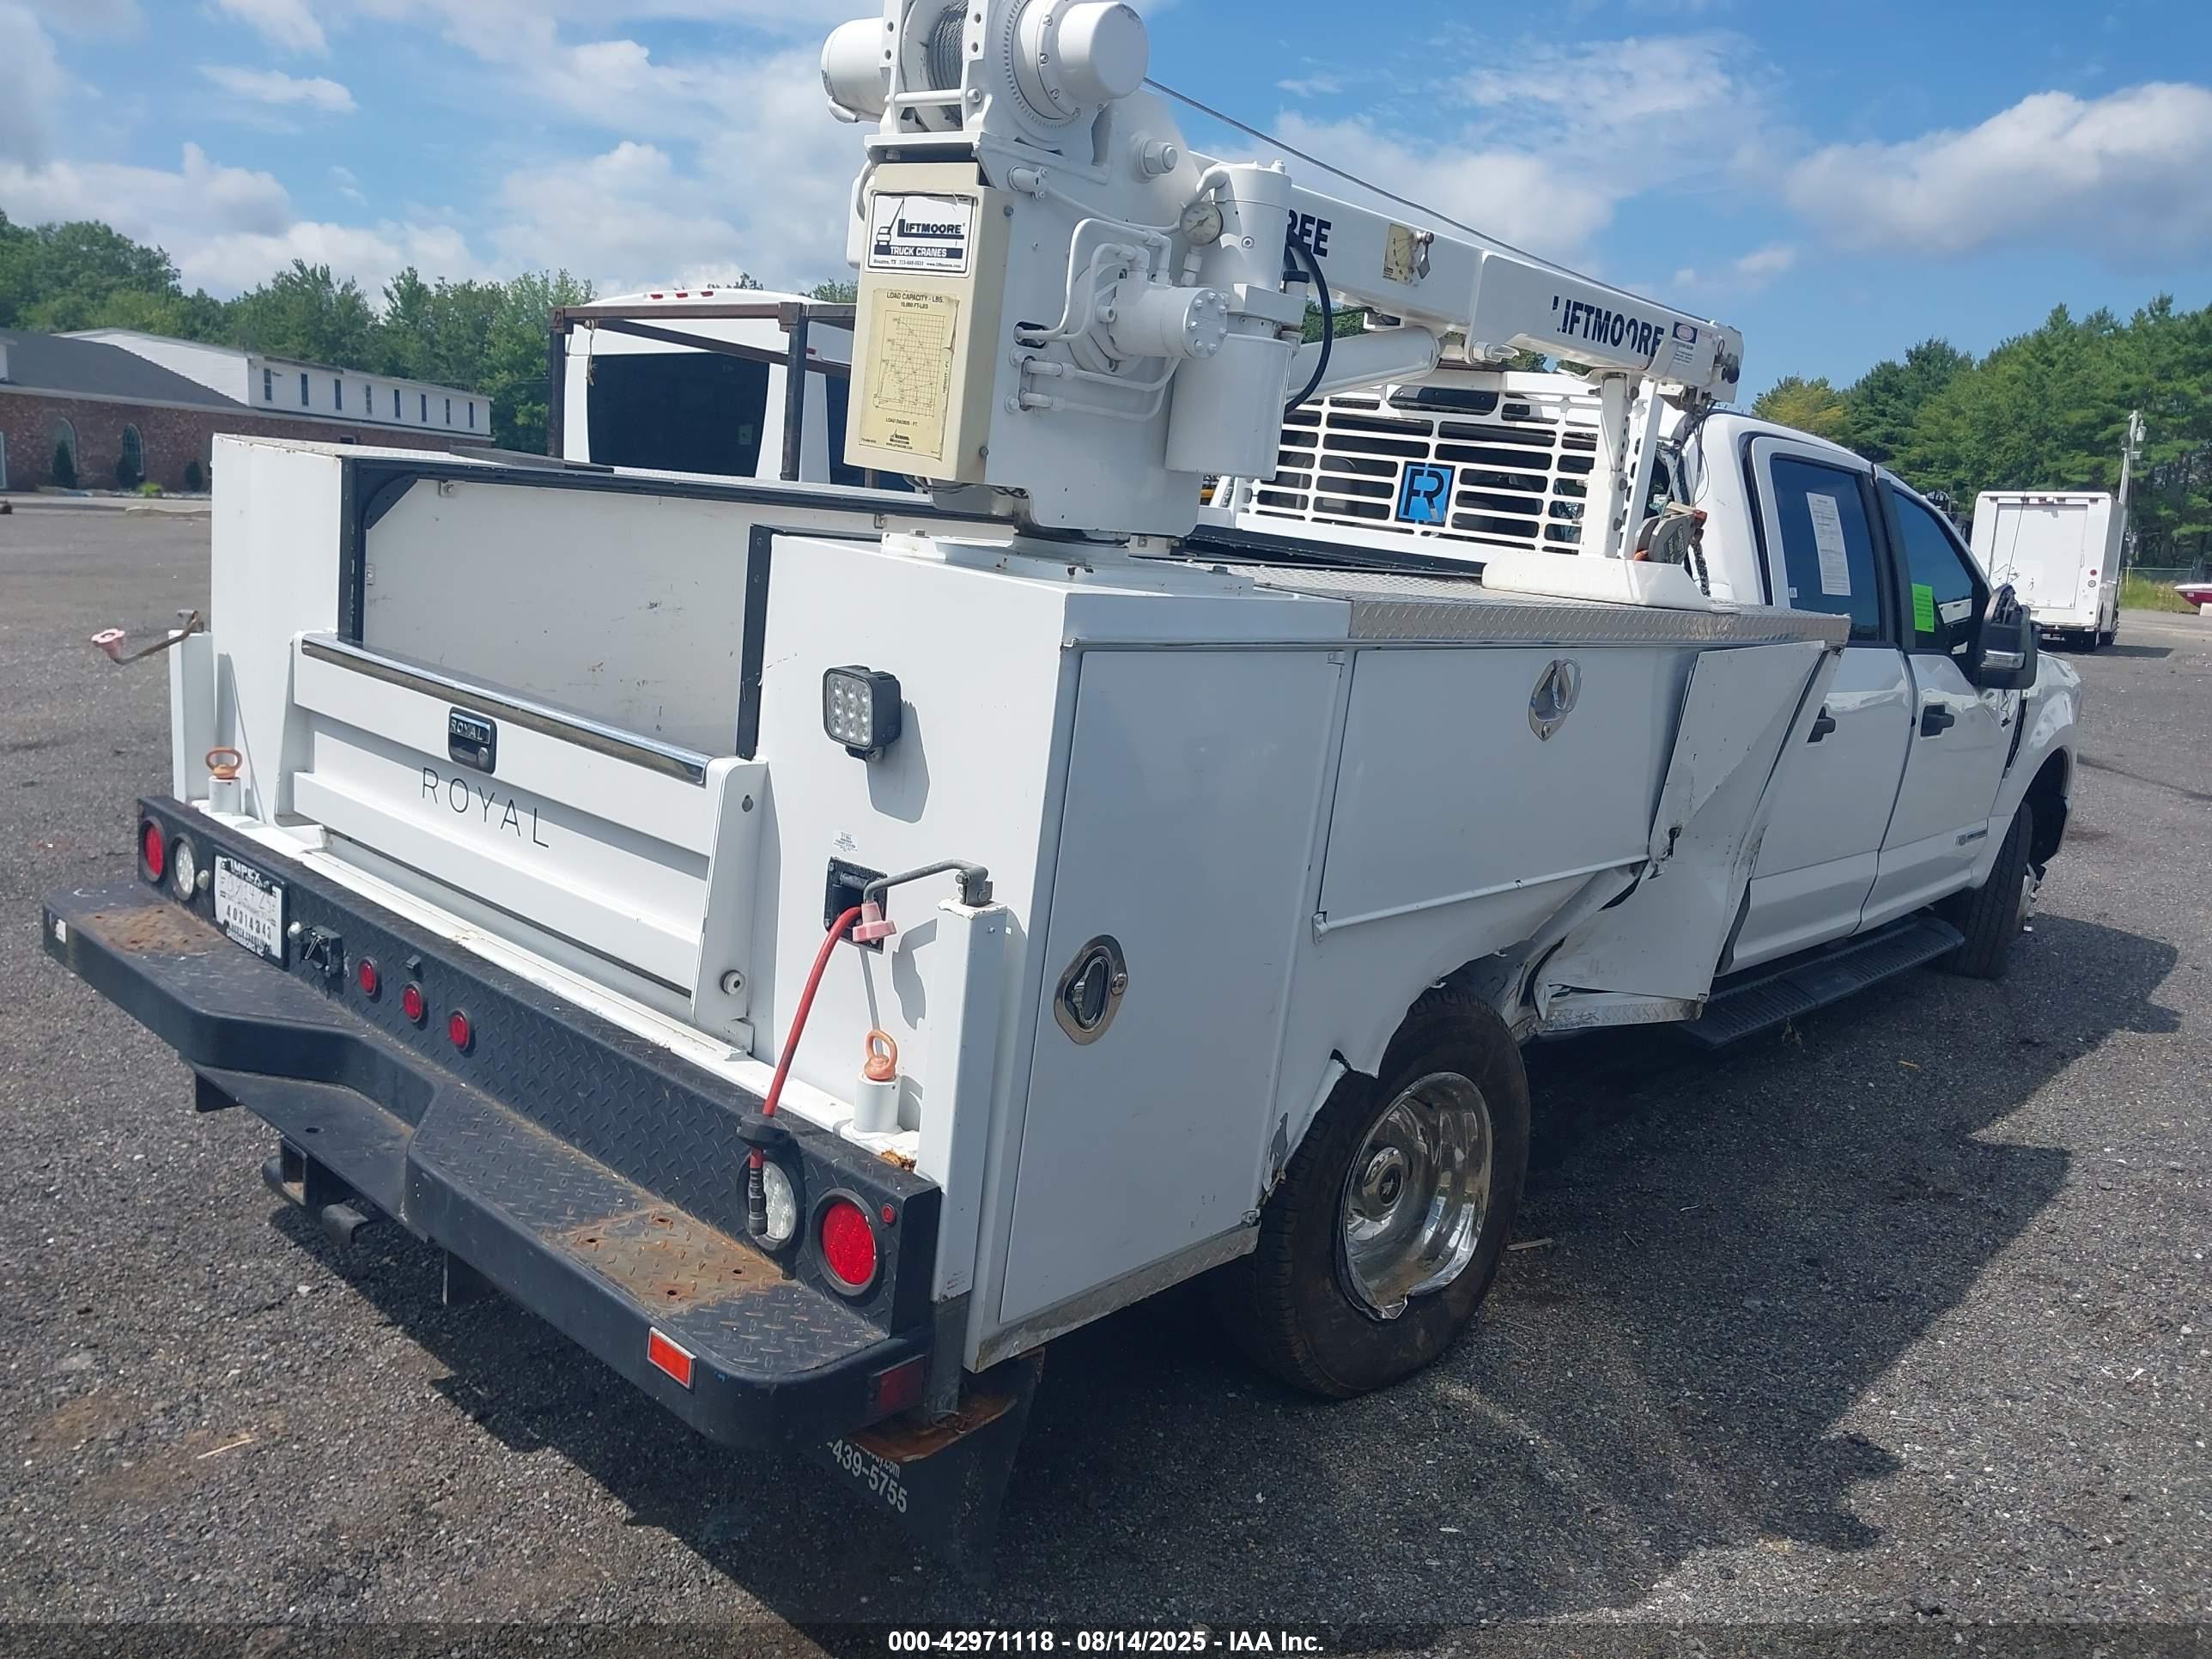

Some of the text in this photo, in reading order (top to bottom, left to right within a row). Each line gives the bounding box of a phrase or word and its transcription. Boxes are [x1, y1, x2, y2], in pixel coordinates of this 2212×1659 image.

[897, 219, 964, 240] LIFTMOORE
[890, 246, 948, 258] TRUCK CRANES
[886, 291, 902, 300] LOAD
[902, 293, 928, 301] CAPACITY
[451, 718, 483, 741] ROYAL
[422, 766, 550, 848] ROYAL
